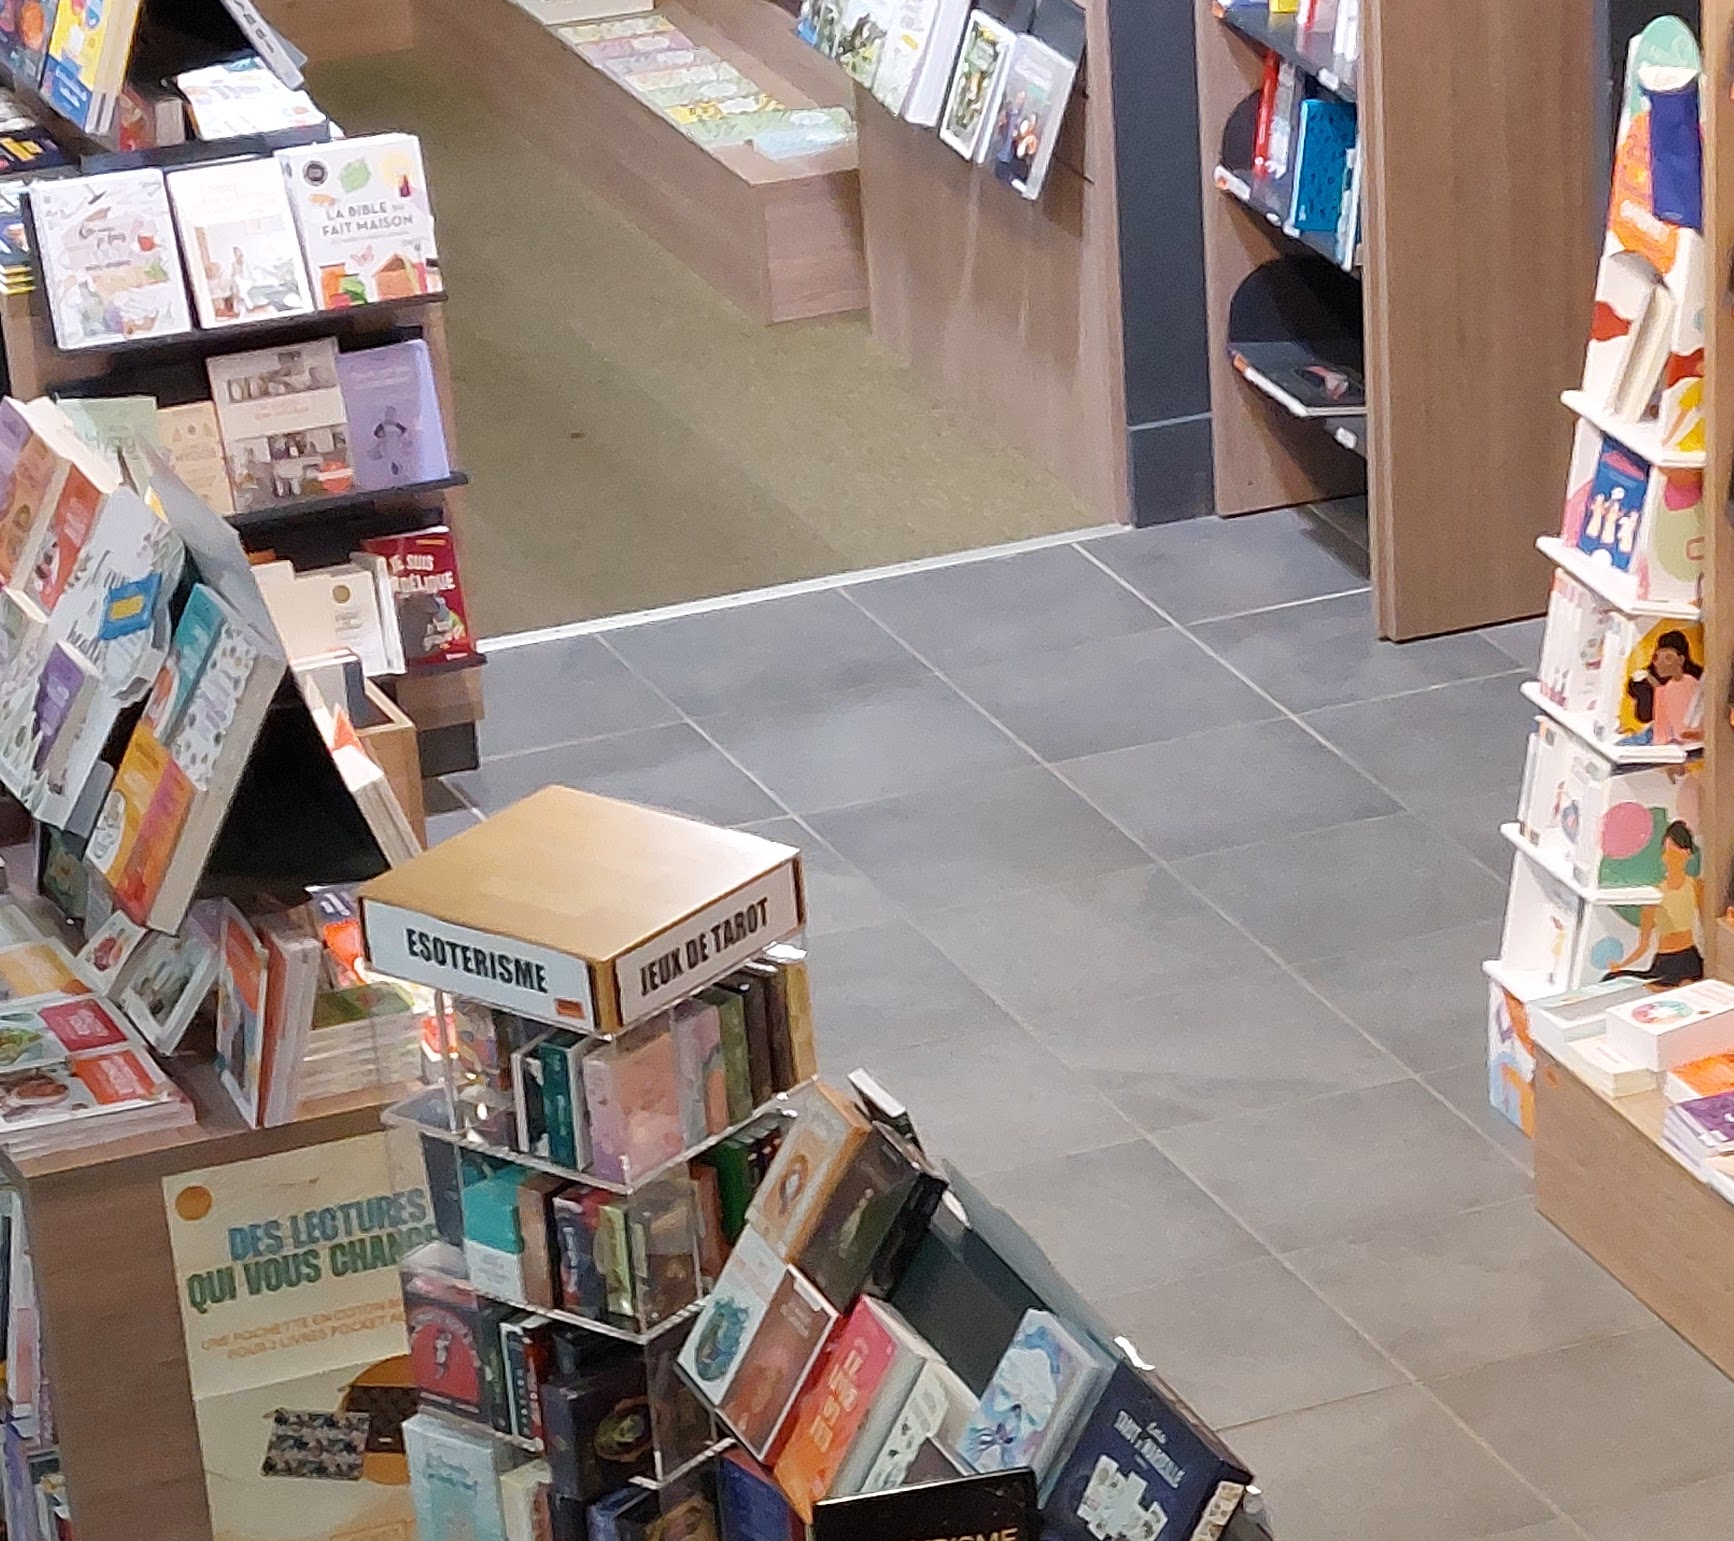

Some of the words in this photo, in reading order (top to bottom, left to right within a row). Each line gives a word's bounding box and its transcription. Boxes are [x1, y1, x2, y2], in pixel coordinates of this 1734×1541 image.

[322, 222, 352, 236] FAIT
[357, 215, 412, 230] MAISON
[326, 209, 344, 220] LA
[348, 202, 387, 215] BIBLE
[404, 927, 549, 994] ESOTERISME
[640, 951, 683, 998] JEUX
[686, 934, 709, 969] DE
[710, 896, 770, 955] TAROT
[228, 1220, 284, 1261] DES
[289, 1188, 426, 1248] LECTURES
[187, 1266, 237, 1314] QUI
[244, 1249, 322, 1296] VOUS
